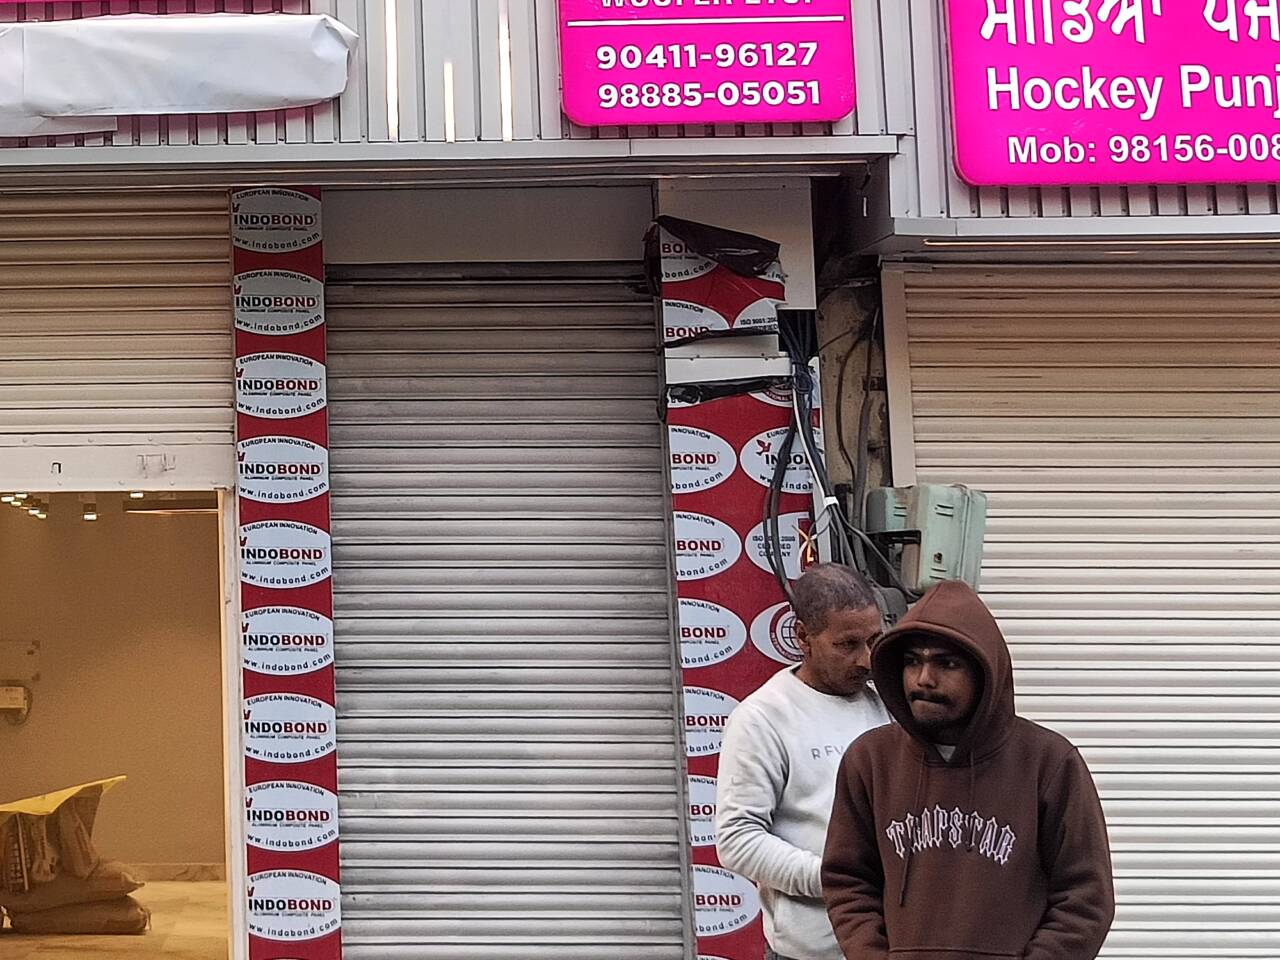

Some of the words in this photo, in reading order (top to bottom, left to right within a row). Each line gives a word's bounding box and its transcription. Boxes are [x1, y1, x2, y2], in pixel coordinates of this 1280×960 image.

[596, 42, 818, 69] 90411-96127
[598, 81, 821, 108] 98885-05051
[987, 65, 1163, 120] Hockey
[1009, 135, 1097, 164] Mob:
[234, 215, 314, 225] INDOBOND
[236, 297, 316, 307] INDOBOND
[240, 354, 274, 364] EUROPEAN
[238, 380, 318, 390] INDOBOND
[671, 428, 710, 439] INNOVATION
[242, 438, 276, 448] EUROPEAN
[673, 454, 717, 464] BOND
[240, 464, 320, 474] INDOBOND
[676, 514, 715, 526] INNOVATION
[243, 523, 278, 532] EUROPEAN
[677, 540, 721, 551] BOND
[242, 548, 322, 559] INDOBOND
[681, 601, 720, 612] INNOVATION
[245, 609, 280, 618] EUROPEAN
[682, 627, 726, 638] BOND
[243, 634, 325, 646] INDOBOND
[247, 696, 282, 705] EUROPEAN
[245, 722, 327, 733] INDOBOND
[249, 783, 284, 793] EUROPEAN
[247, 810, 330, 821] INDOBOND
[251, 872, 286, 882] EUROPEAN
[249, 899, 332, 910] INDOBOND
[696, 895, 741, 906] BOND
